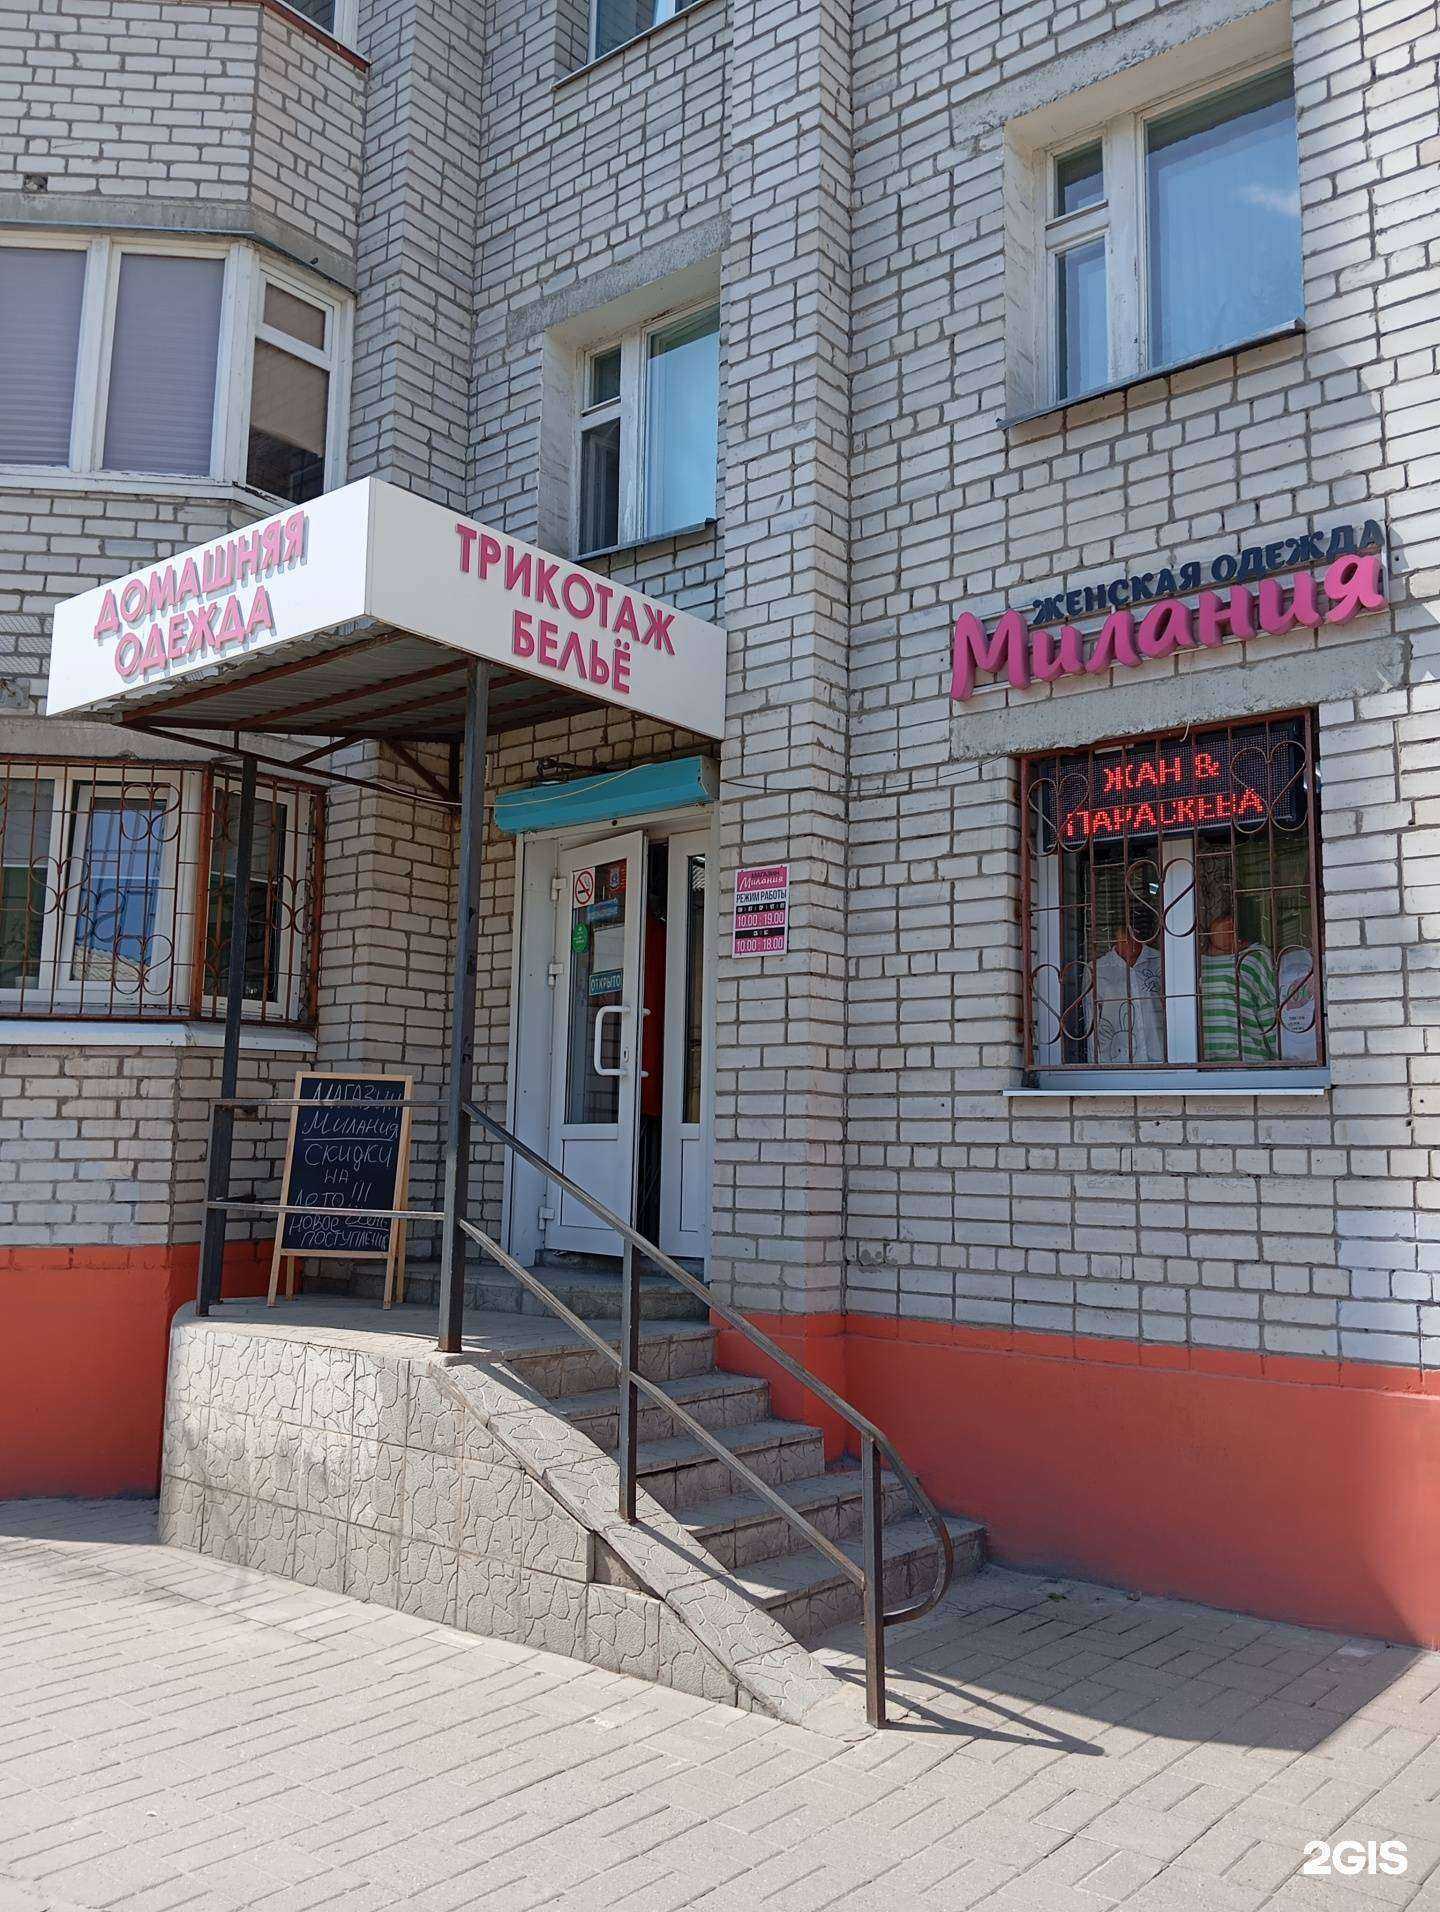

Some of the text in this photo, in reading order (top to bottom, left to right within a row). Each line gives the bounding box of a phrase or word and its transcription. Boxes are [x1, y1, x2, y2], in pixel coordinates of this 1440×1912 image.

[93, 510, 306, 640] ДОМАШНЯЯ
[455, 523, 676, 656] ТРИКОТАЖ
[1032, 519, 1386, 625] ЖЕНСКАЯ ОДЕЖДА
[113, 585, 276, 678] ОДЕЖДА
[511, 609, 632, 695] БЕЛЬЁ
[951, 553, 1386, 701] Милания
[1104, 757, 1181, 792] ЖАН
[736, 889, 787, 903] РЕЖИМ РАБОТЫ
